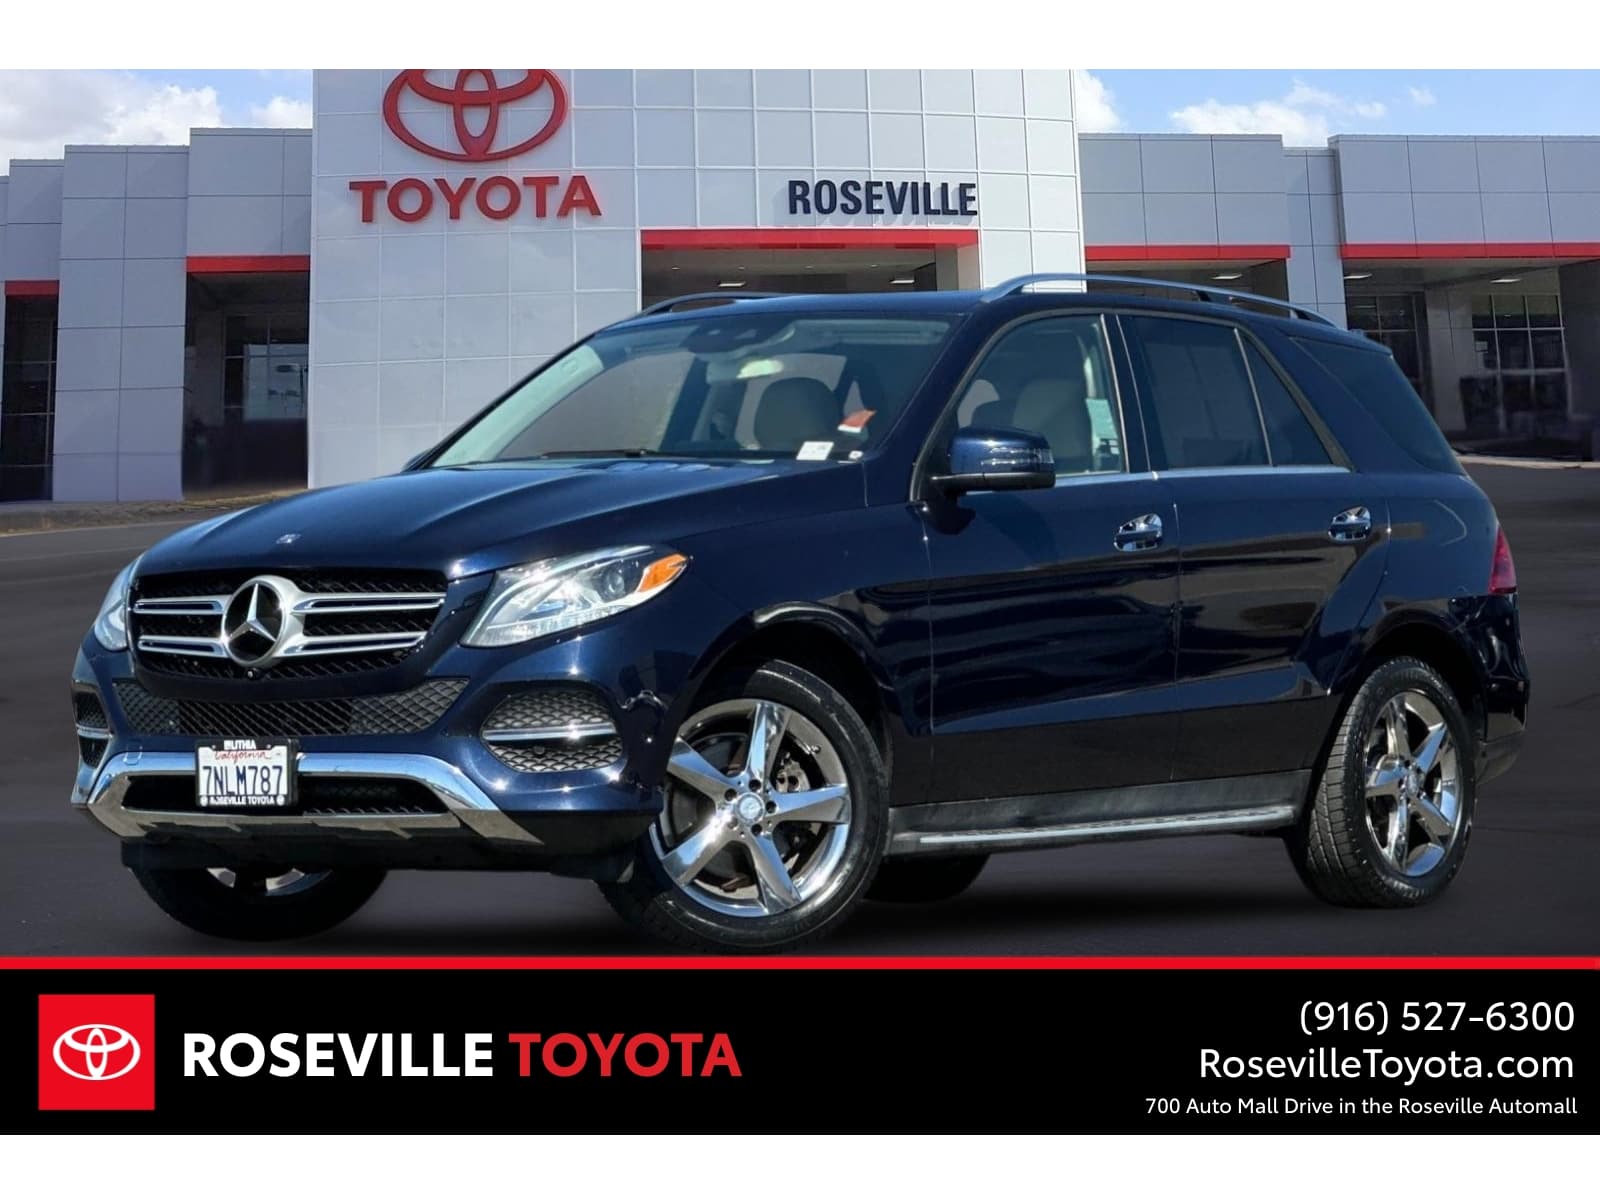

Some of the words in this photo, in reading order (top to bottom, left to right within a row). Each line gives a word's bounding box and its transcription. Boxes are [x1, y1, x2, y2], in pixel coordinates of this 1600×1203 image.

[349, 175, 602, 223] TOYOTA
[788, 180, 978, 216] ROSEVILLE
[203, 765, 283, 796] 7NLM787
[248, 795, 275, 806] TOYOTA
